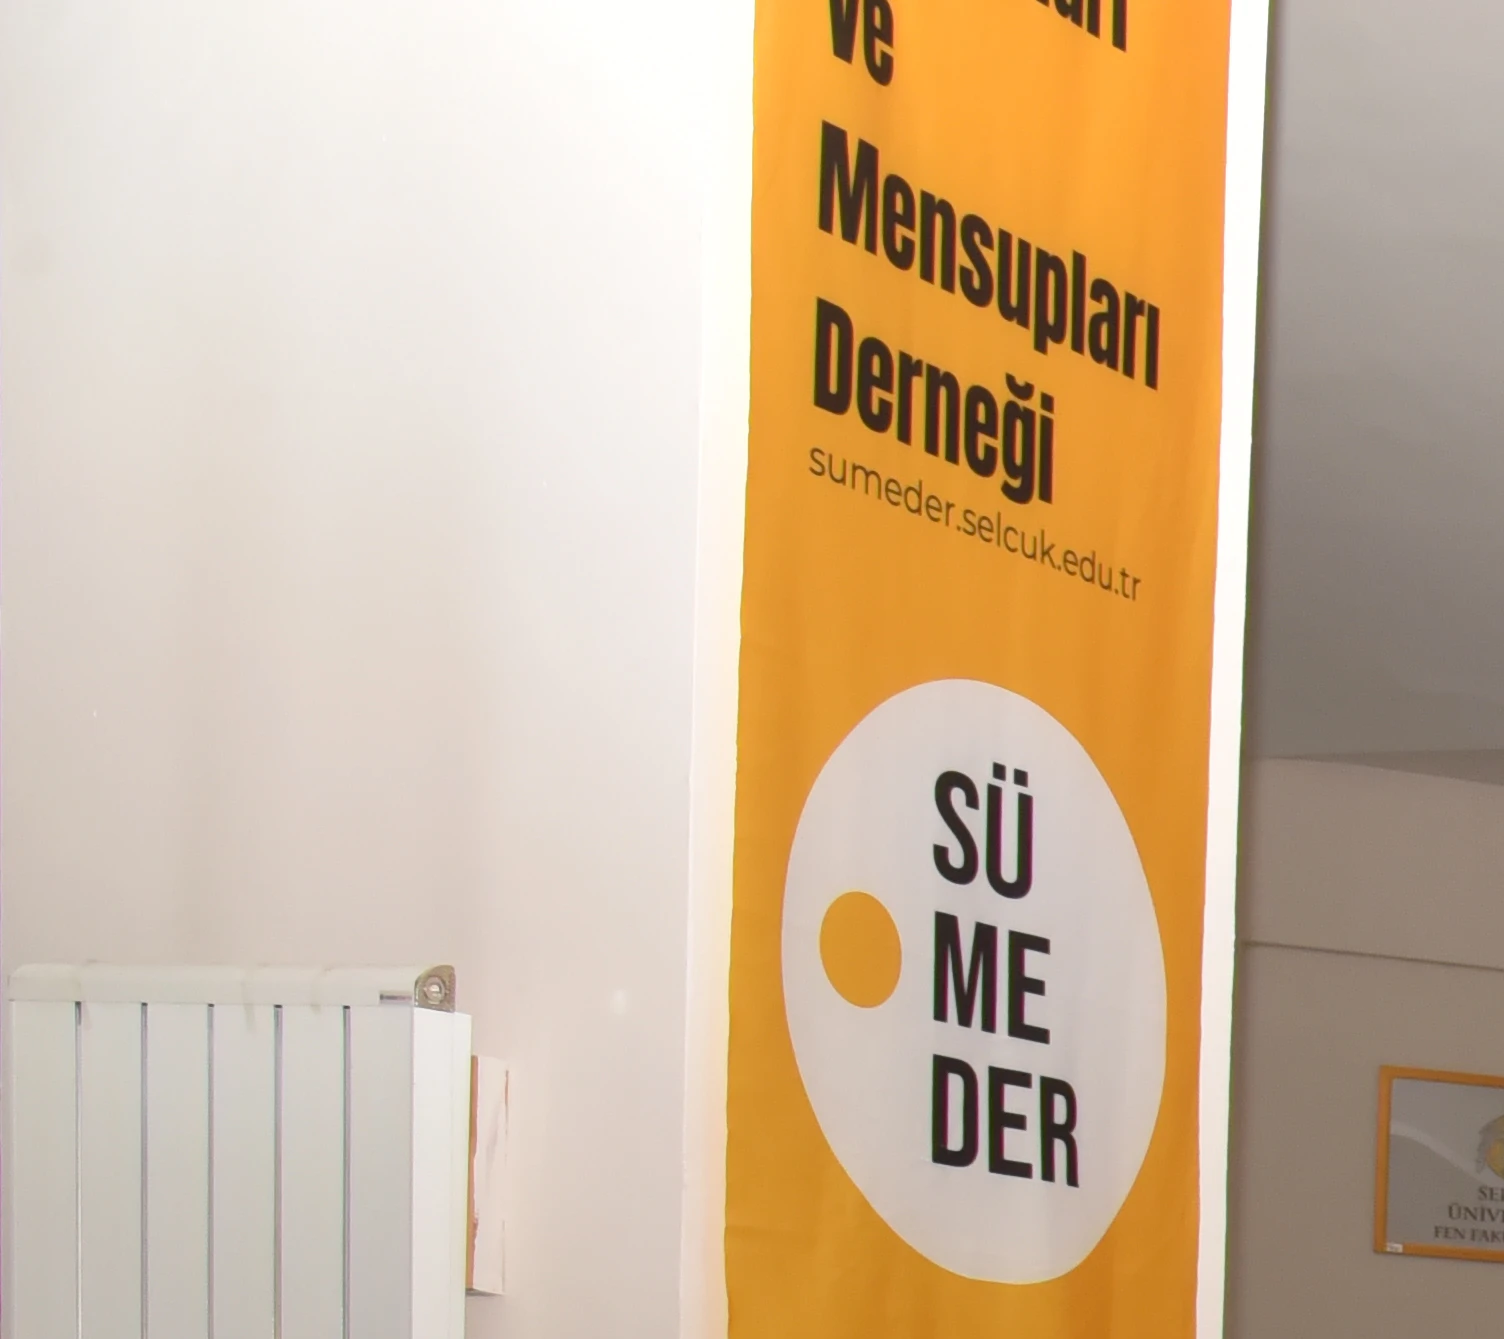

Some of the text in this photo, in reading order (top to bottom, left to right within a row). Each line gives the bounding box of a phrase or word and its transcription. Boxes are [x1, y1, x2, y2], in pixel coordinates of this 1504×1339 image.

[817, 118, 1161, 392] Mensupları
[812, 295, 1055, 505] Derneği
[808, 445, 1142, 603] sumeder.selcuk.edu.tr
[932, 761, 1034, 900] SÜ
[933, 910, 1051, 1045] ME
[931, 1053, 1080, 1188] DER
[1432, 1225, 1467, 1241] FEN
